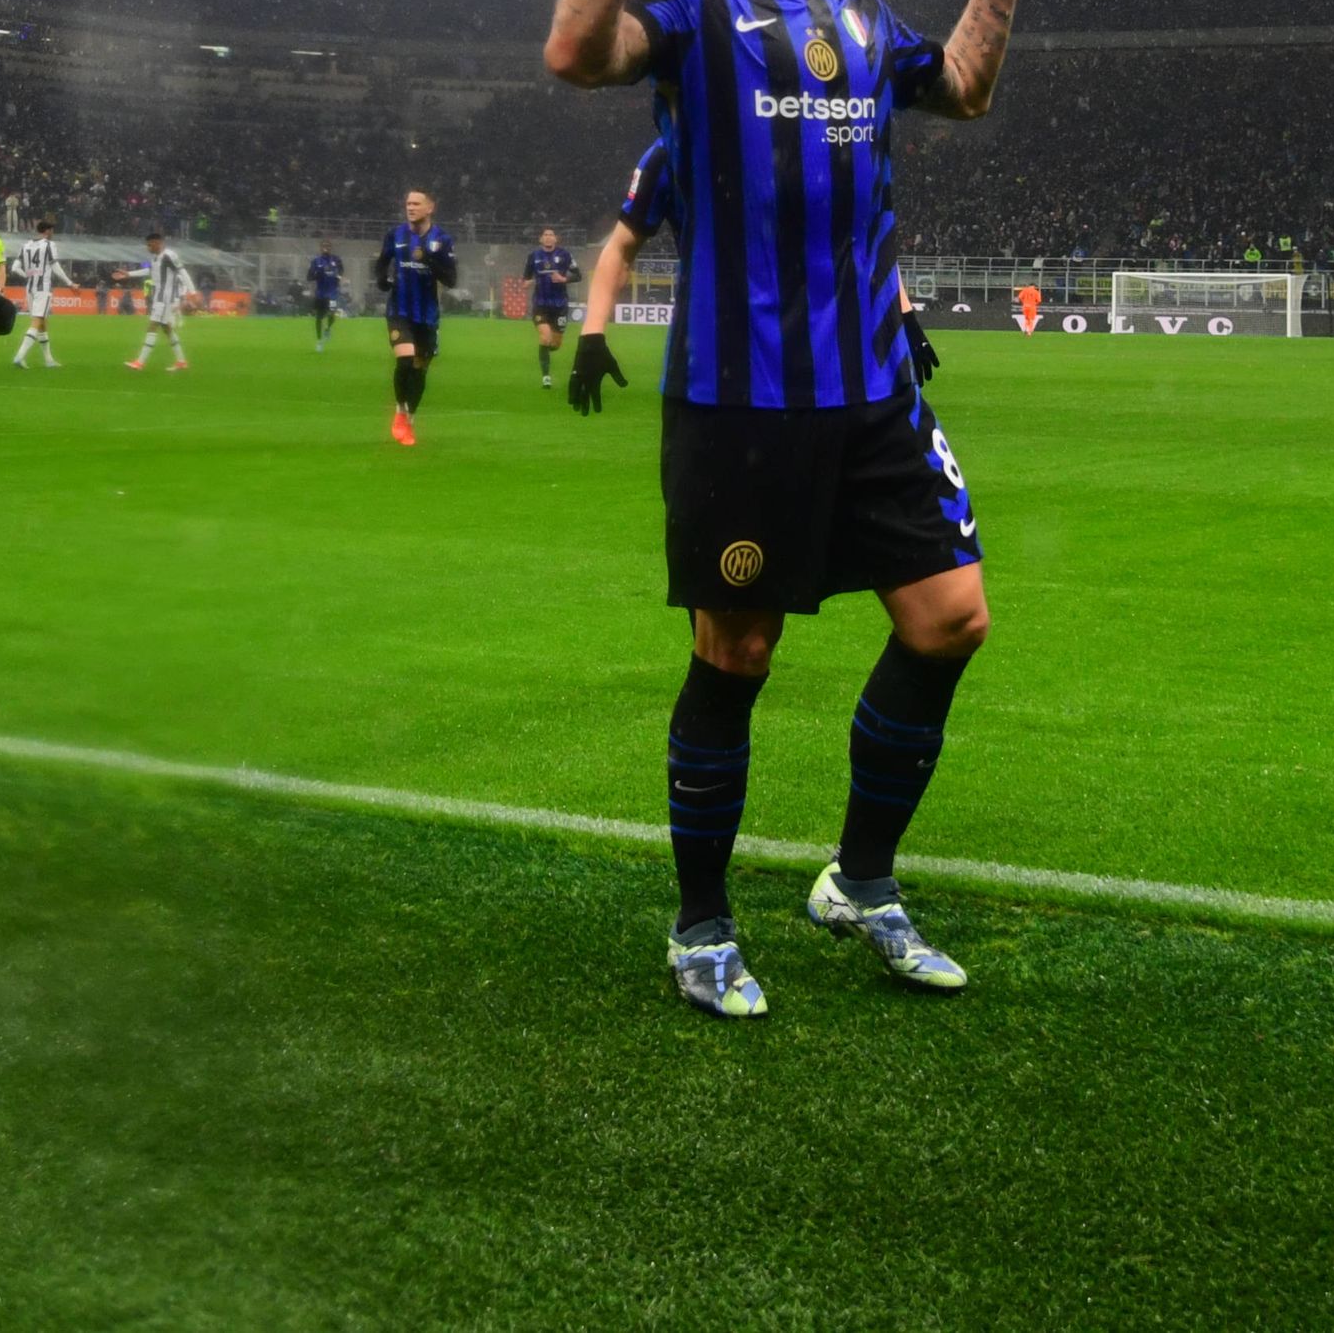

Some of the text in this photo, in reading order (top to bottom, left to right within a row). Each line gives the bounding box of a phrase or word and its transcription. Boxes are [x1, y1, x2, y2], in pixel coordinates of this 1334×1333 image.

[754, 89, 876, 120] betsson
[821, 122, 875, 148] .sport
[25, 247, 41, 269] 14
[621, 306, 669, 323] BPER
[932, 428, 965, 489] 8
